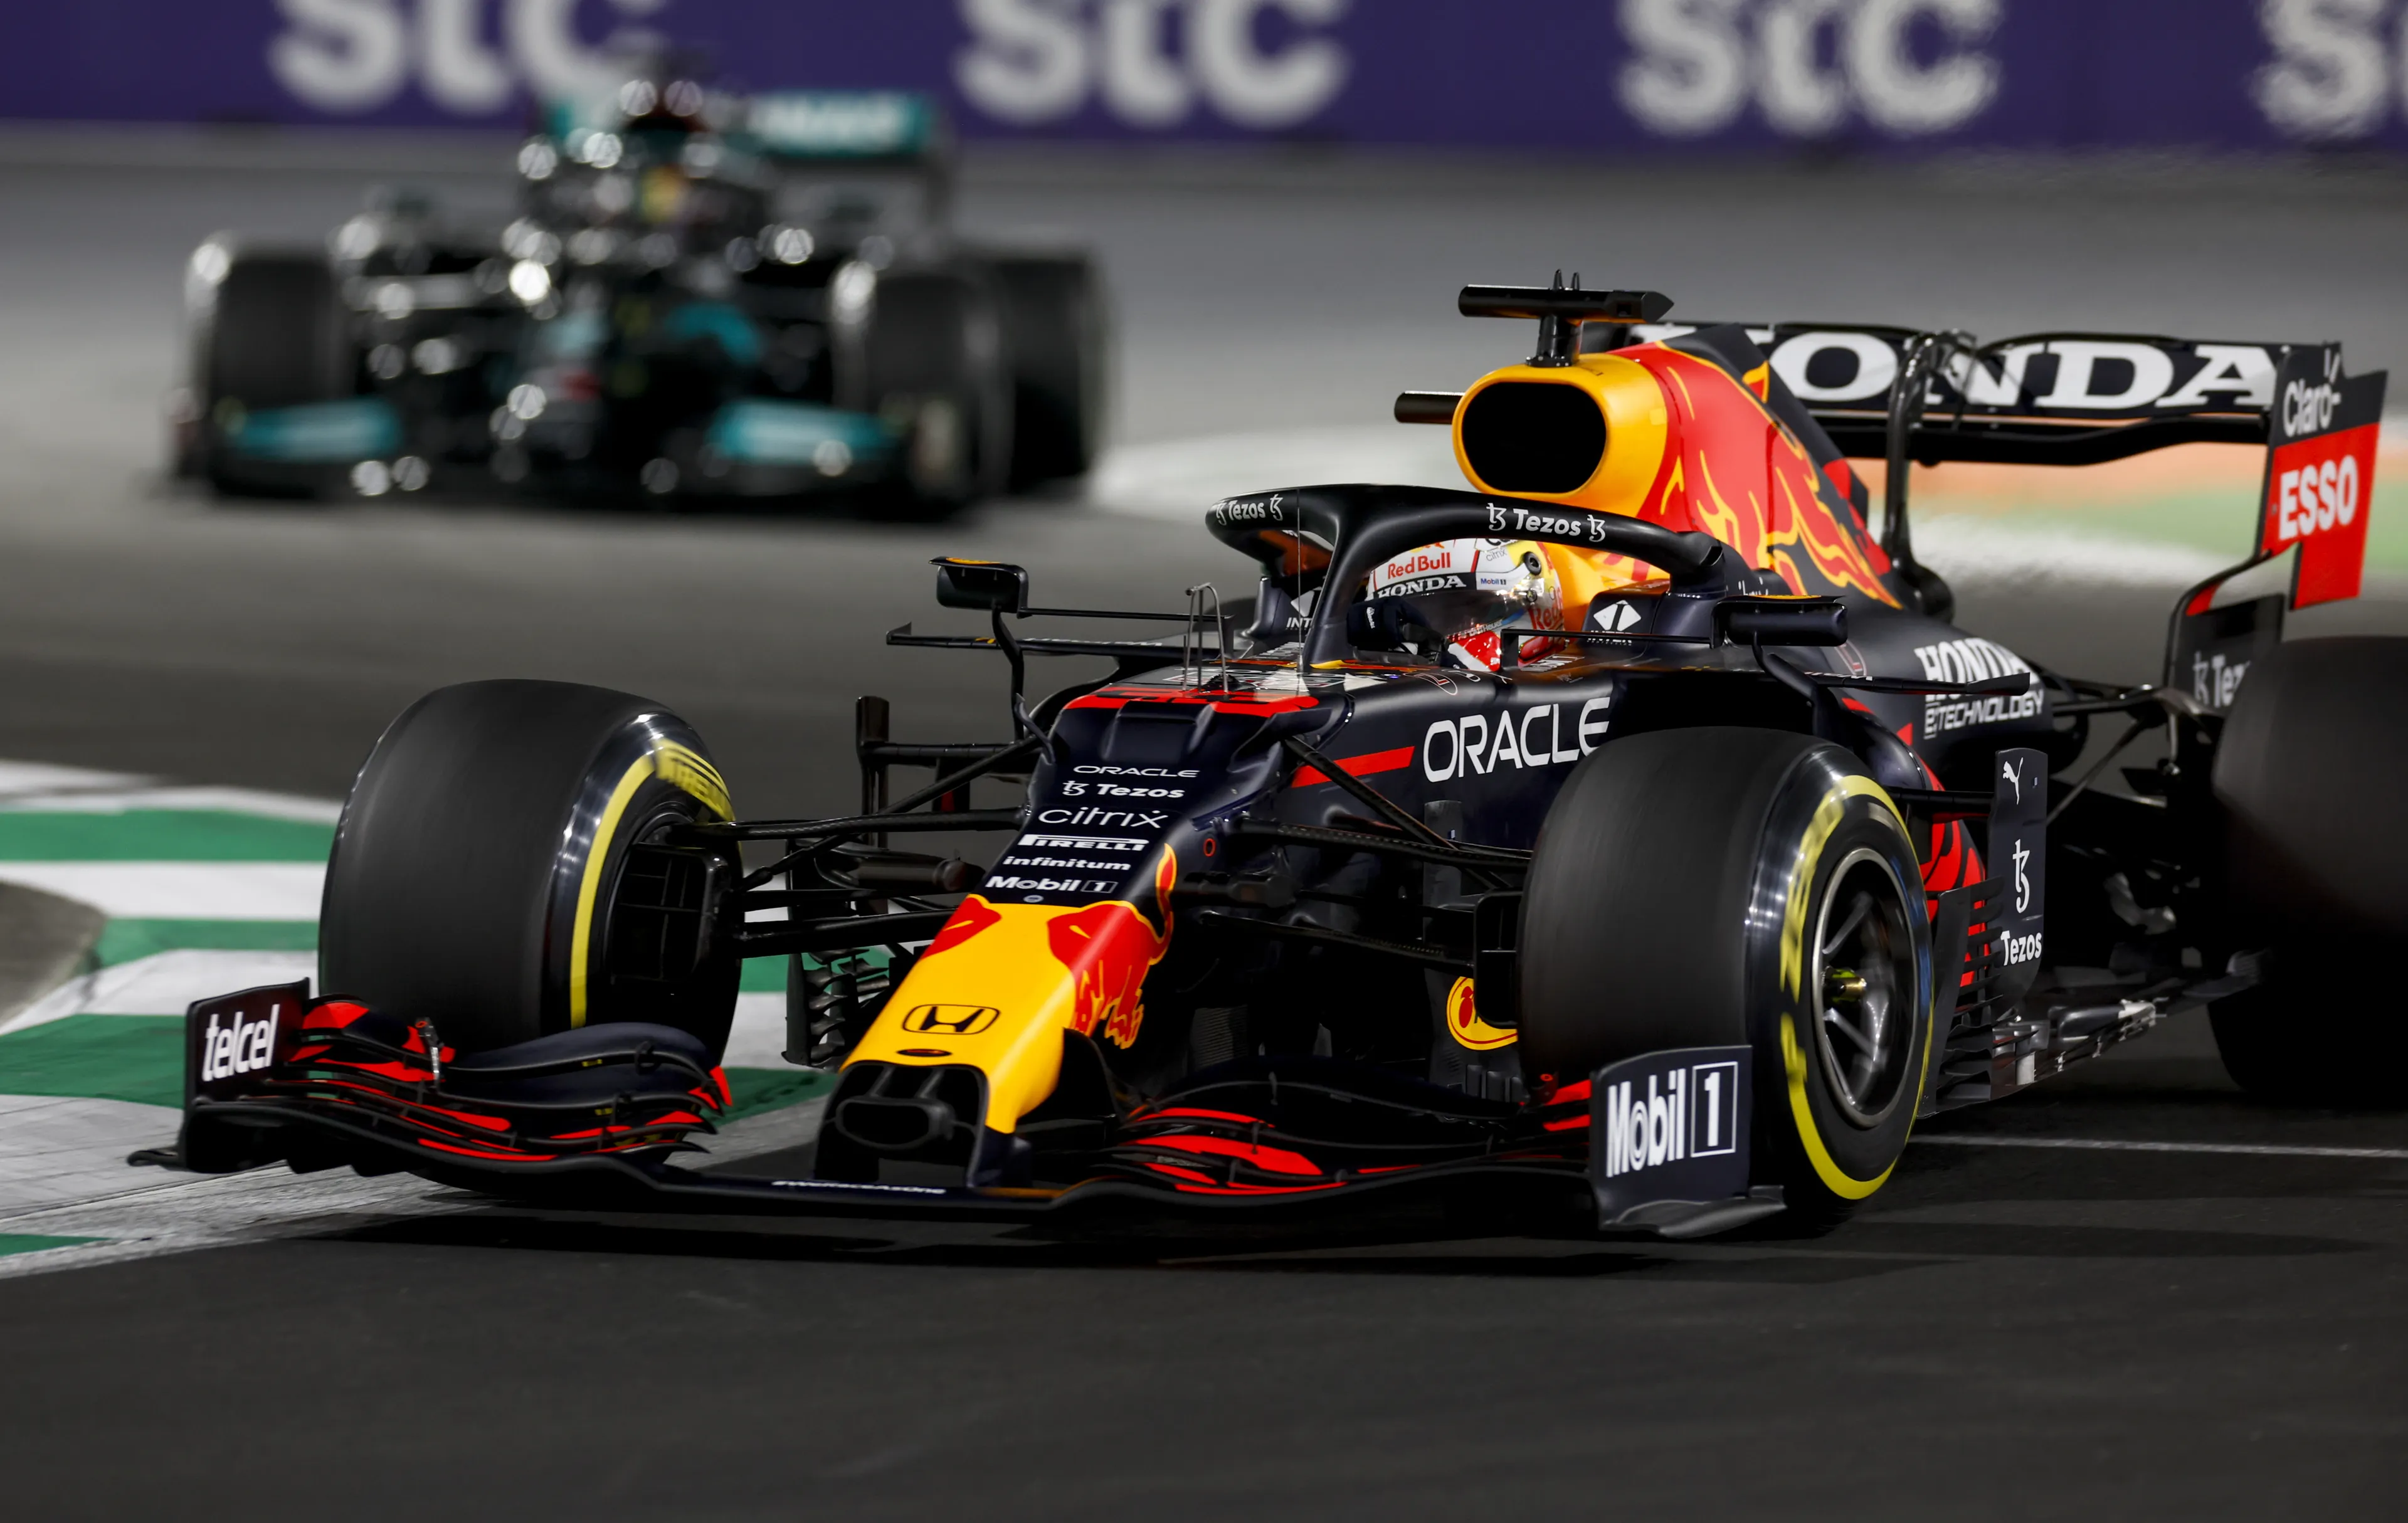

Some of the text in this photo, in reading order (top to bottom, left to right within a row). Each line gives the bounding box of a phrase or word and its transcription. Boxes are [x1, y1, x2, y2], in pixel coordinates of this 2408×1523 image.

[1630, 325, 2275, 409] ONDA
[1228, 500, 1265, 520] Tezos
[2279, 455, 2359, 541] ESSO
[1513, 508, 1582, 536] Tezos
[1388, 552, 1450, 579] Red Bull
[1377, 575, 1466, 598] HONDA
[1286, 617, 1313, 628] INT
[1914, 637, 2041, 703] HONDA
[1423, 697, 1610, 783] ORACLE
[1073, 766, 1200, 777] ORACLE
[1097, 784, 1185, 798] Tezos
[1018, 834, 1149, 851] PIRELLI
[1003, 856, 1131, 870] infinitum
[985, 876, 1082, 892] Mobil
[2000, 930, 2042, 966] Tezos
[202, 1004, 280, 1082] telcel
[1607, 1068, 1686, 1178] Mobil
